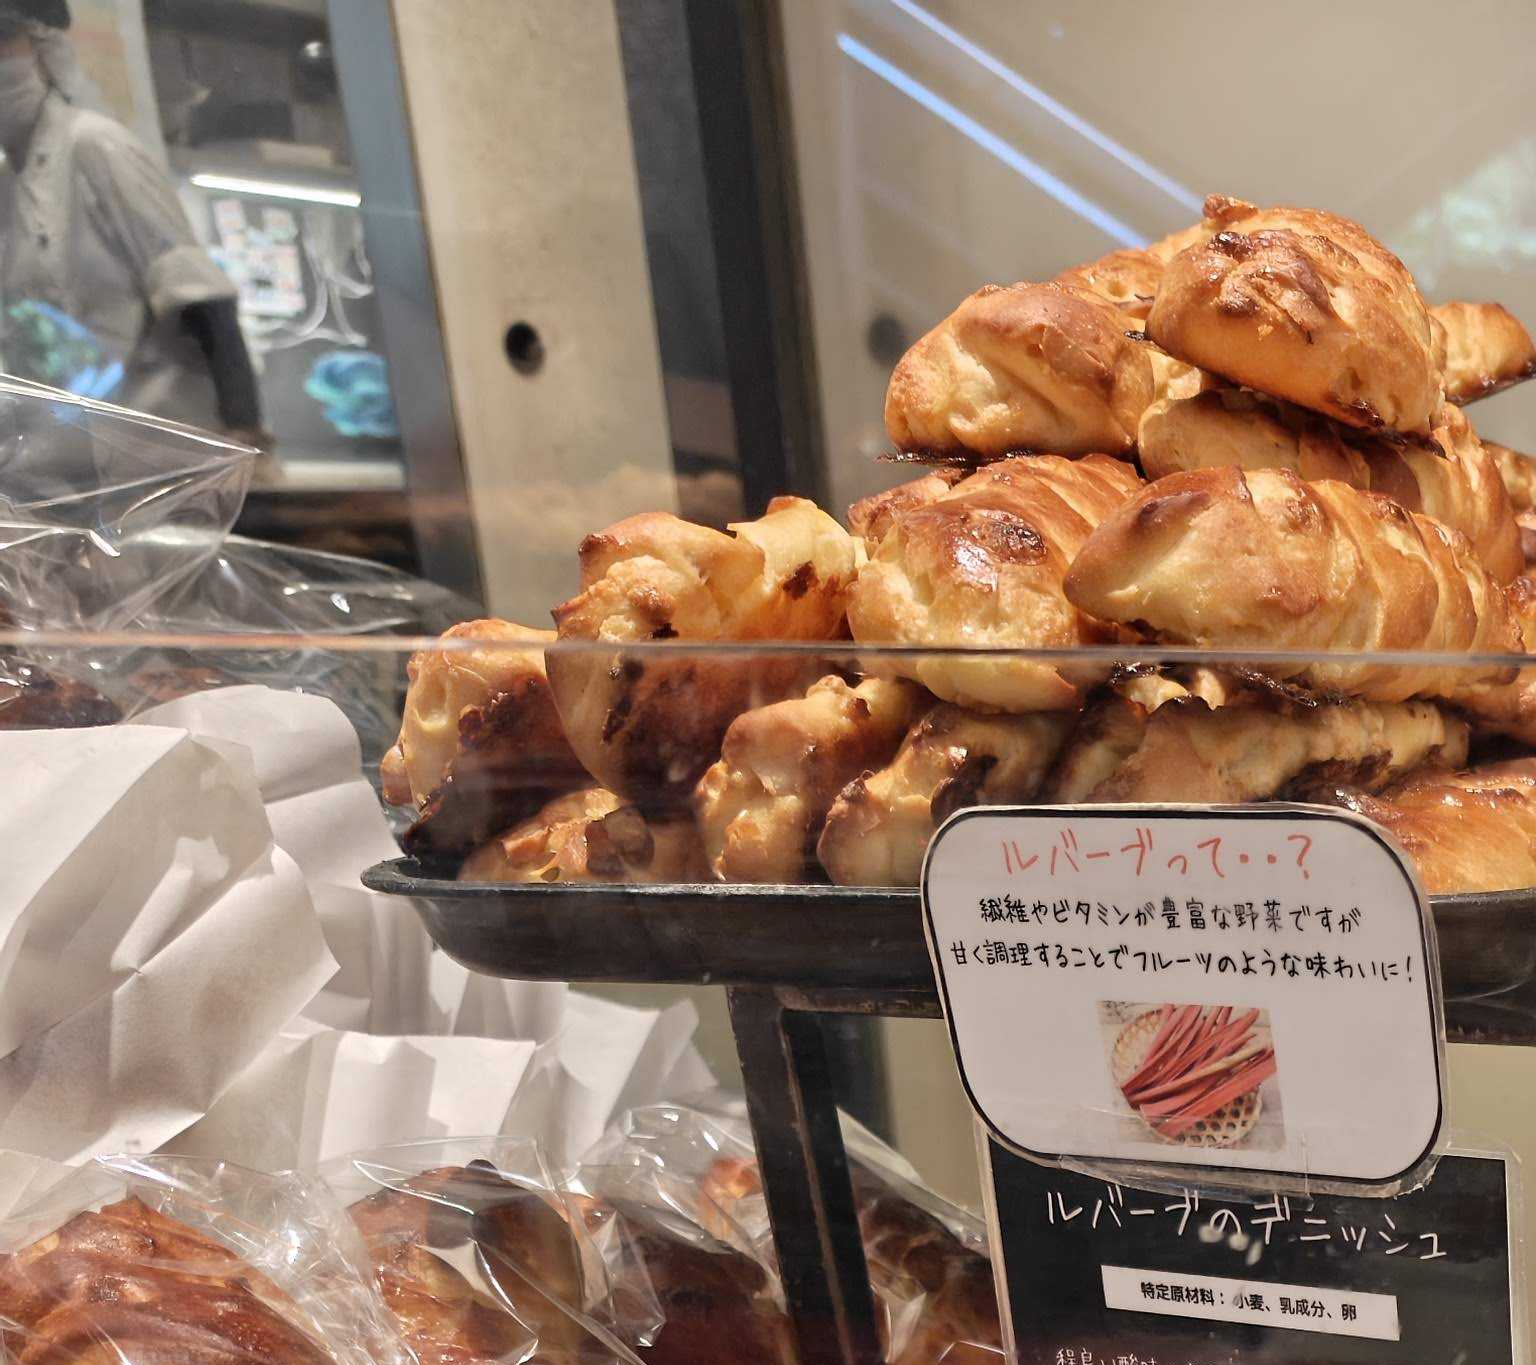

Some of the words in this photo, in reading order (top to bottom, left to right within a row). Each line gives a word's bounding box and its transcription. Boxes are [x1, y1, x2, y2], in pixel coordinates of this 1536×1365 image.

[979, 893, 1362, 933] 繊維やビタミンが豊富な野菜ですが
[1046, 1183, 1448, 1260] ルバーブのデニッシュ
